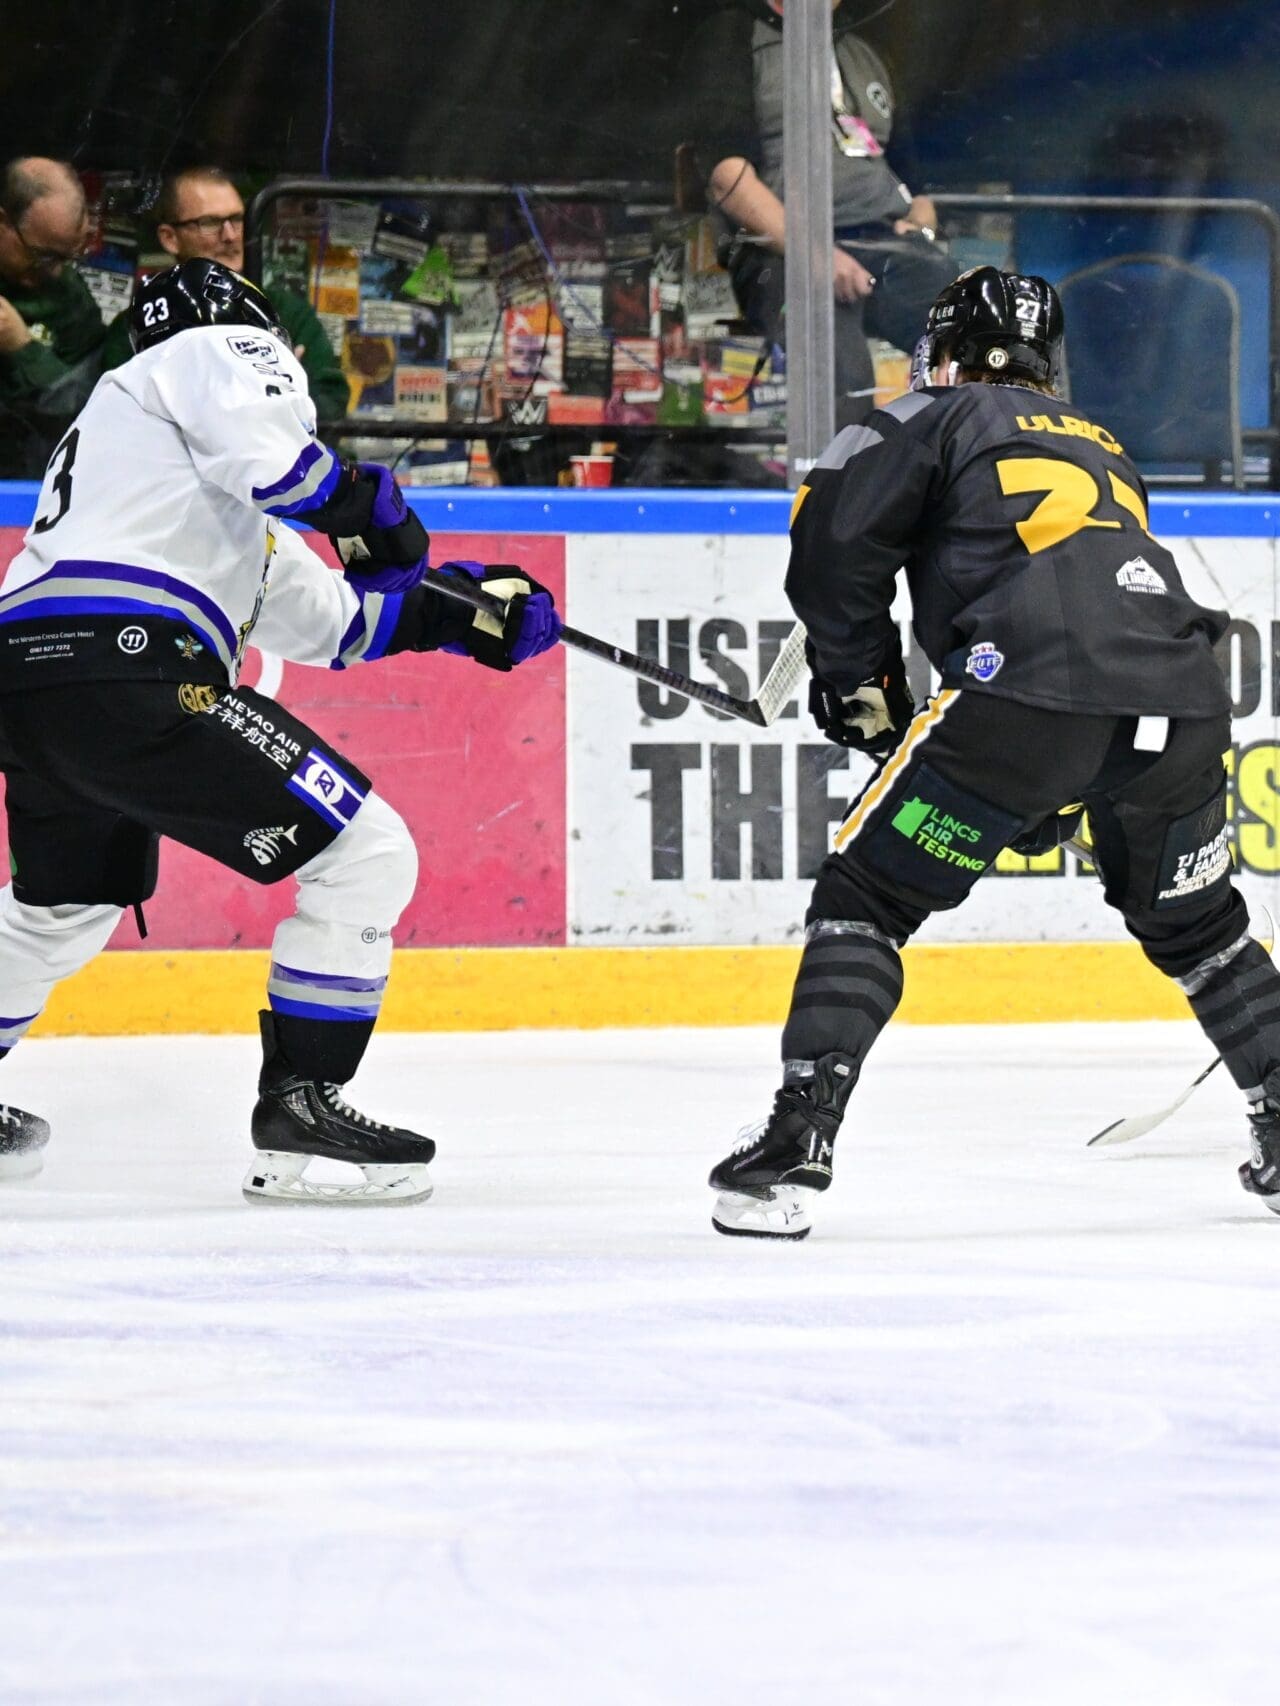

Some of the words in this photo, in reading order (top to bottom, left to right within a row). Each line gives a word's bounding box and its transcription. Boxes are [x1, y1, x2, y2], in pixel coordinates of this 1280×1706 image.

[143, 297, 169, 327] 23
[1015, 298, 1040, 321] 27
[990, 353, 1003, 365] 47
[636, 618, 799, 721] USE
[968, 657, 1001, 671] ELITE
[219, 694, 275, 734] NEYAO
[274, 732, 302, 756] AIR
[630, 742, 850, 880] THE
[921, 822, 953, 846] AIR
[929, 808, 982, 843] LINCS
[916, 831, 986, 871] TESTING
[1178, 852, 1195, 868] TJ
[1173, 867, 1187, 882] &
